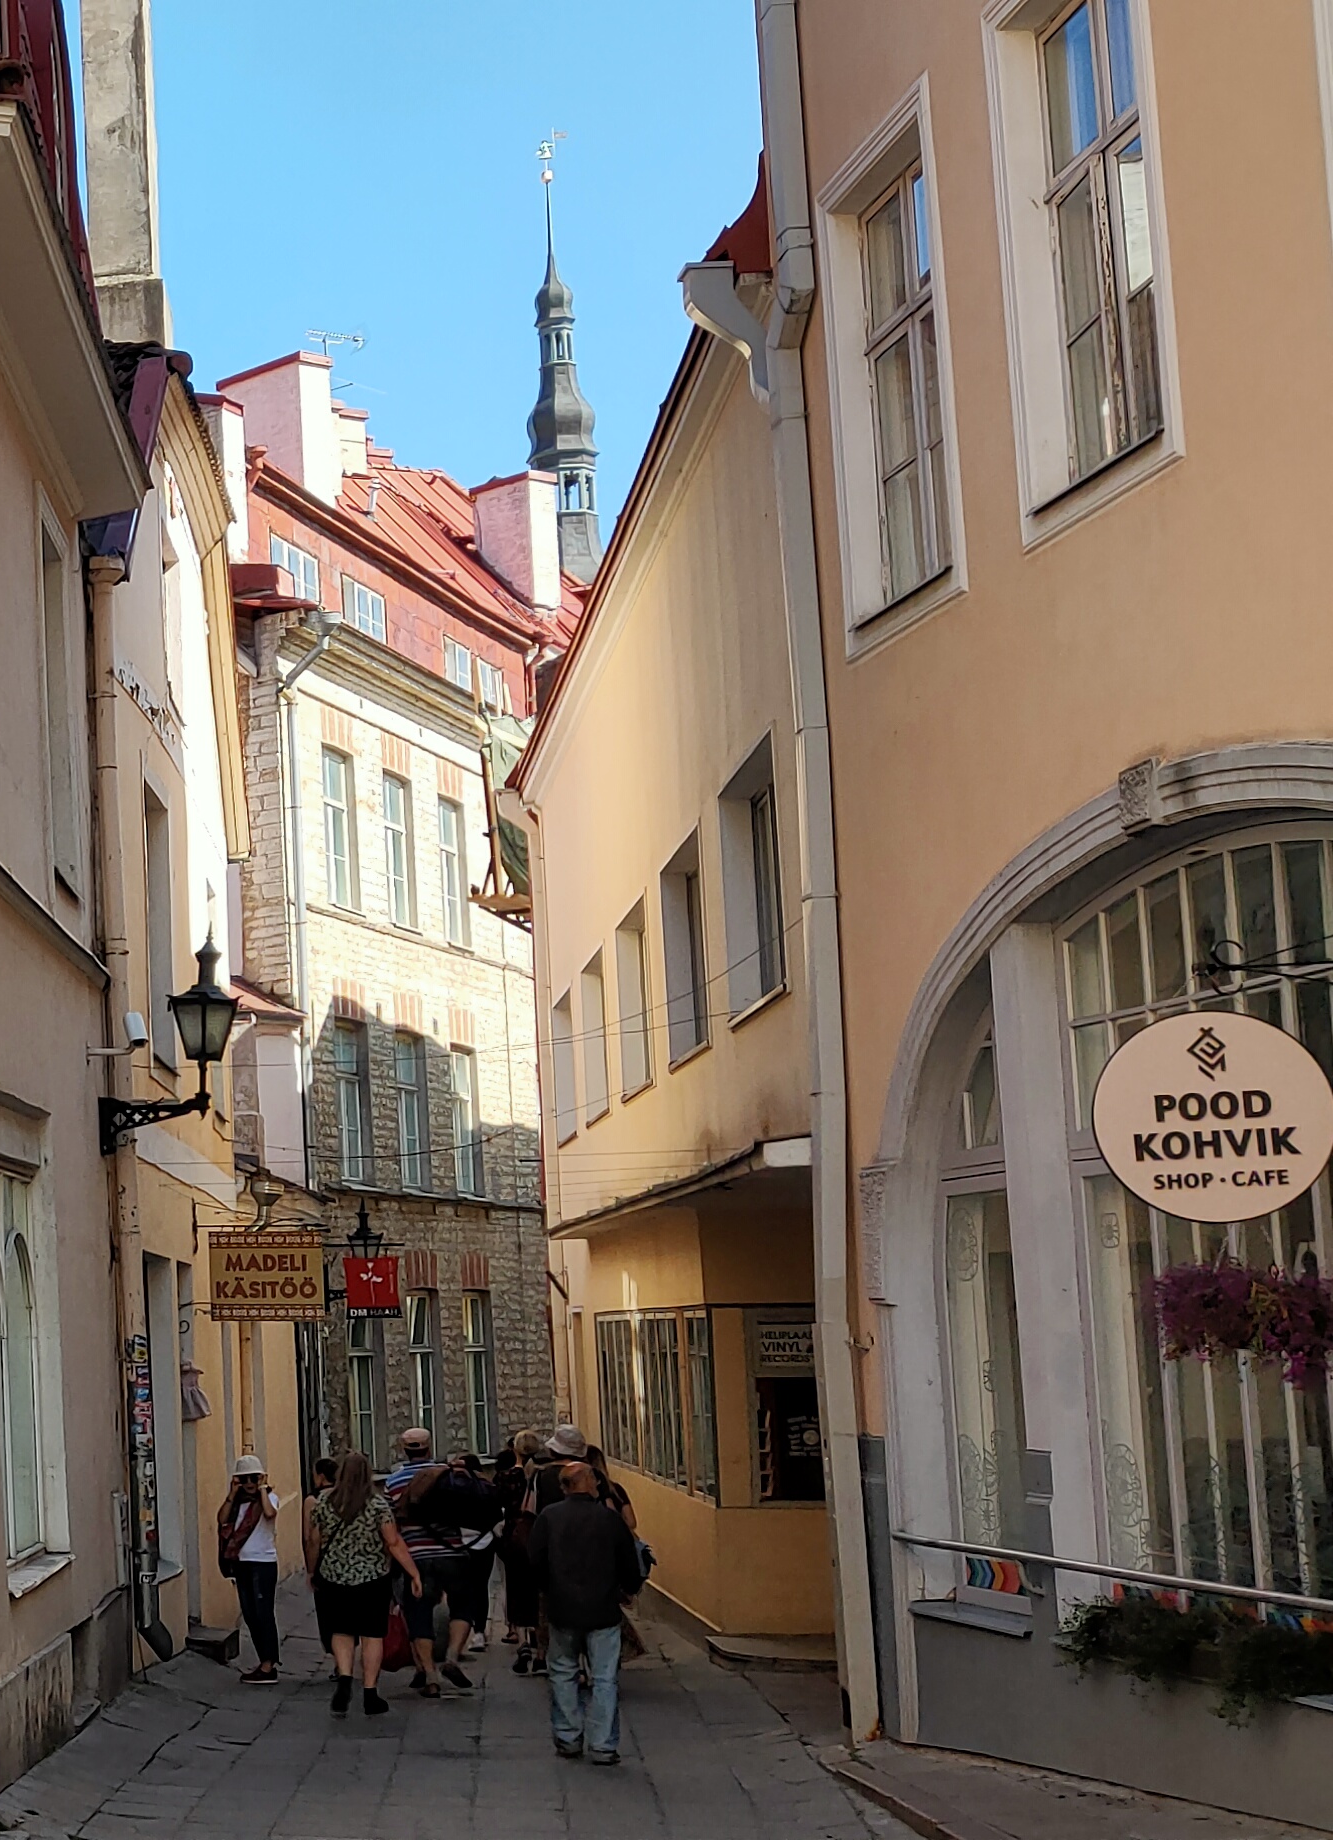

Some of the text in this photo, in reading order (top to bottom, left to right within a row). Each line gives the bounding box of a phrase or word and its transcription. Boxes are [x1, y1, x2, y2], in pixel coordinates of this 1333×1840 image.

[1153, 1090, 1272, 1123] POOD
[1133, 1126, 1303, 1162] KOHVIK
[1153, 1169, 1290, 1190] SHOP CAFE
[225, 1253, 308, 1272] MADELI
[216, 1276, 318, 1299] KÄSITÖÖ
[350, 1308, 367, 1317] DM
[761, 1341, 802, 1353] VINYL
[760, 1354, 811, 1363] RECORDS
